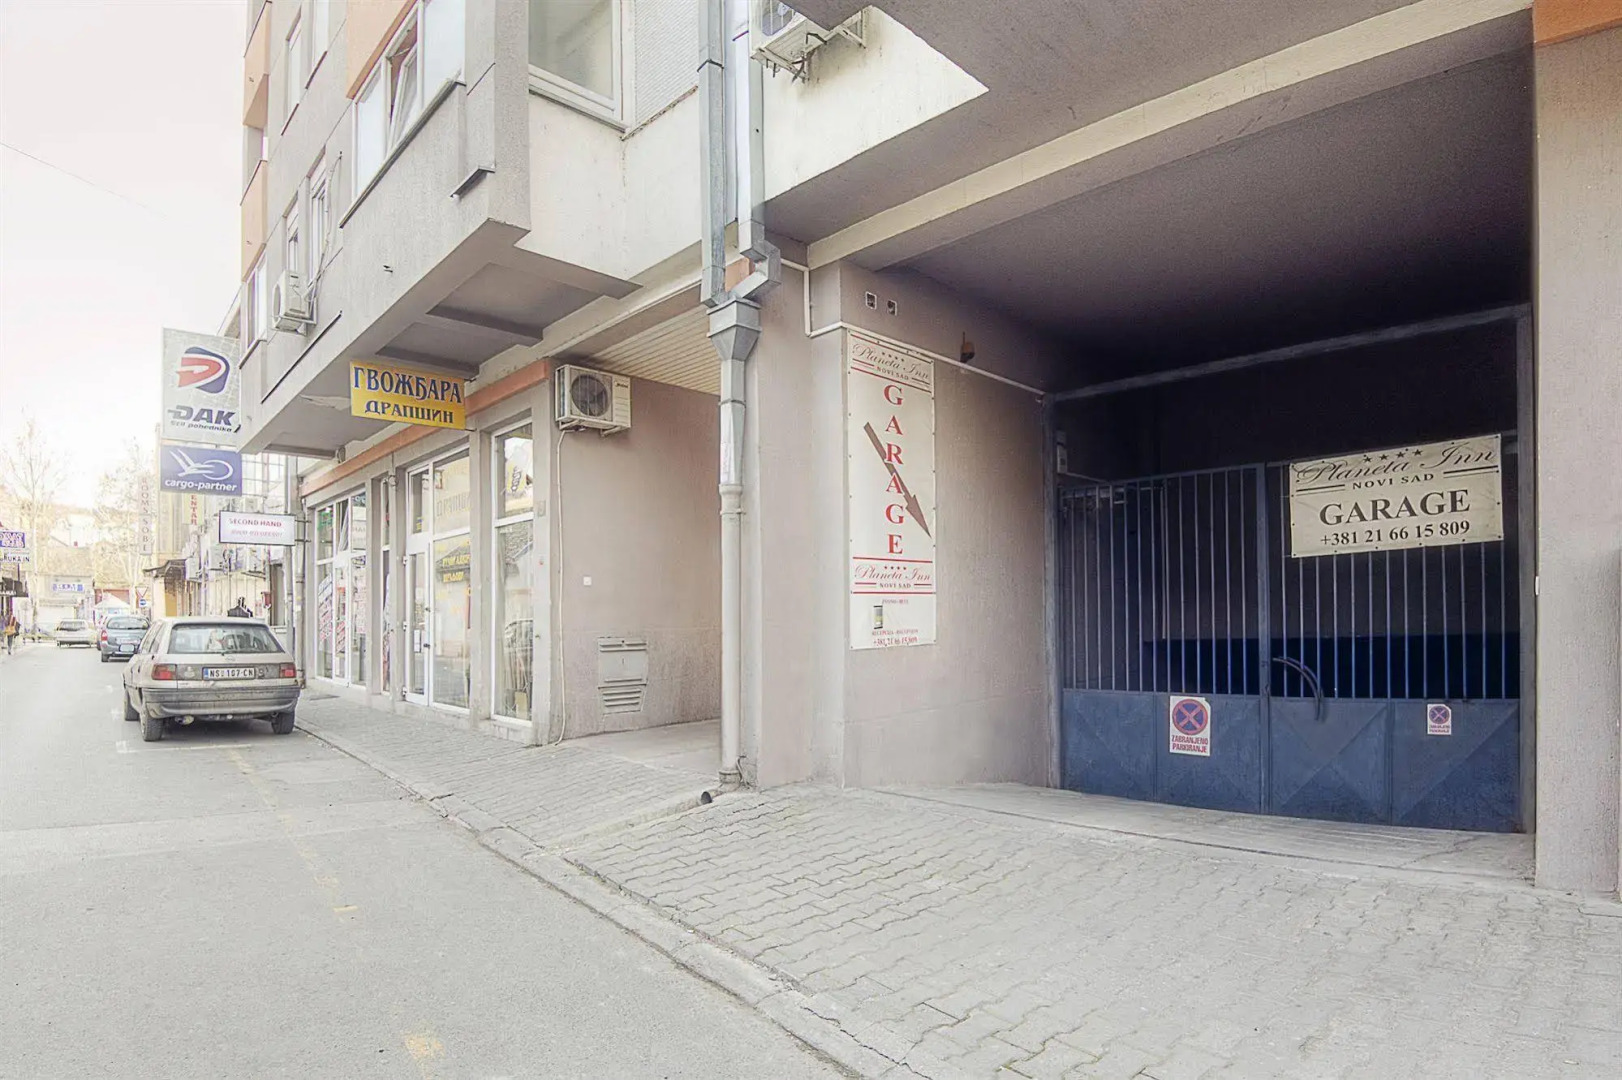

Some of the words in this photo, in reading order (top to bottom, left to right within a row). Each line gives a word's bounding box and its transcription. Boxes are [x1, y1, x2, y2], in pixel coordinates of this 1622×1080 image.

[877, 366, 894, 375] NOVI
[167, 405, 236, 426] DAK
[364, 400, 454, 424] ДРАПШИН
[883, 384, 905, 555] GARAGE
[1295, 458, 1411, 484] Planeta
[1419, 441, 1497, 469] Inn
[164, 479, 238, 492] cargo-partner
[1352, 477, 1394, 490] NOVI
[1400, 472, 1435, 483] SAD
[1319, 489, 1471, 526] GARAGE
[229, 518, 259, 526] SECOND
[1320, 532, 1358, 546] +381
[1365, 529, 1382, 542] 21
[1389, 526, 1409, 541] 66
[1416, 524, 1434, 538] 15
[1439, 520, 1470, 536] 809
[854, 564, 902, 580] Planeta
[905, 567, 931, 581] Inn
[209, 669, 221, 678] NS
[1172, 735, 1208, 745] ZABRANJENO
[1172, 743, 1207, 752] PARKIRANJE
